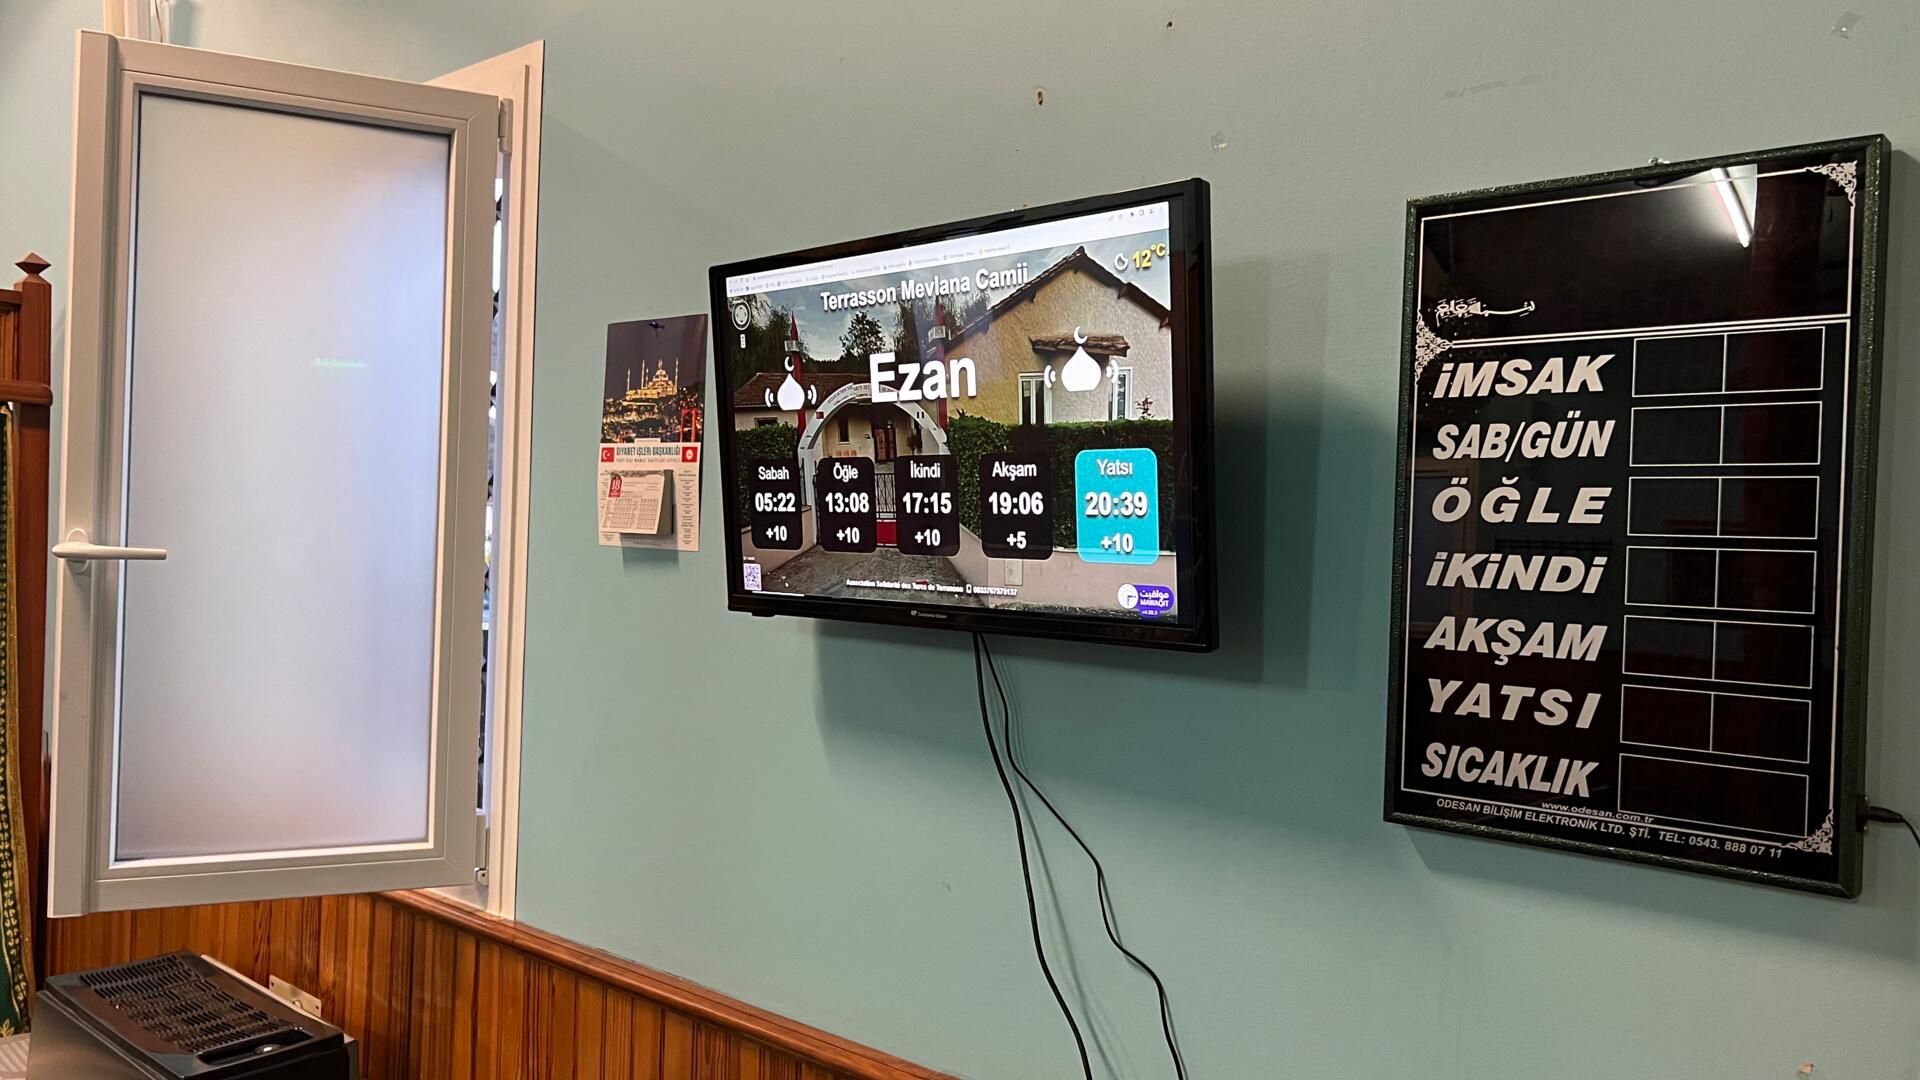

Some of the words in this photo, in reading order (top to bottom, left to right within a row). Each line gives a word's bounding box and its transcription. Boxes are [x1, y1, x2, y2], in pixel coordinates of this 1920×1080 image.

[820, 287, 897, 312] Terrasson
[901, 275, 971, 302] Mevlana
[975, 262, 1029, 291] Camii
[869, 352, 977, 403] Ezan
[1432, 410, 1616, 462] SAB/GÜN
[758, 466, 789, 480] Sabah
[833, 462, 859, 482] Öğle
[910, 460, 941, 478] İkindi
[992, 461, 1037, 481] Akşam
[1097, 458, 1133, 475] Yatsı
[612, 480, 621, 491] 18
[755, 492, 796, 512] 05:22
[825, 492, 870, 513] 13:08
[902, 492, 952, 514] 17:15
[988, 491, 1044, 515] 19:06
[1085, 491, 1148, 516] 20:39
[1431, 476, 1612, 524] ÖĞLE
[765, 525, 788, 541] +10
[836, 527, 860, 544] +10
[914, 529, 941, 546] +10
[1006, 531, 1027, 549] +5
[1101, 533, 1134, 552] +10
[1423, 615, 1608, 666] AKŞAM
[1427, 678, 1602, 729] YATSI
[1421, 742, 1600, 798] SICAKLIK
[1541, 802, 1655, 824] www.odesan.com.tr
[1436, 798, 1480, 812] ODESAN
[1482, 804, 1522, 819] BİLİŞİM
[1524, 811, 1598, 831] ELEKTRONİK
[1600, 823, 1625, 835] LTD.
[1629, 827, 1651, 839] ŞTİ.
[1658, 831, 1685, 844] TEL:
[1688, 836, 1721, 849] 0543.
[1724, 841, 1747, 853] 888
[1749, 845, 1766, 856] 07
[1769, 848, 1783, 859] 11
